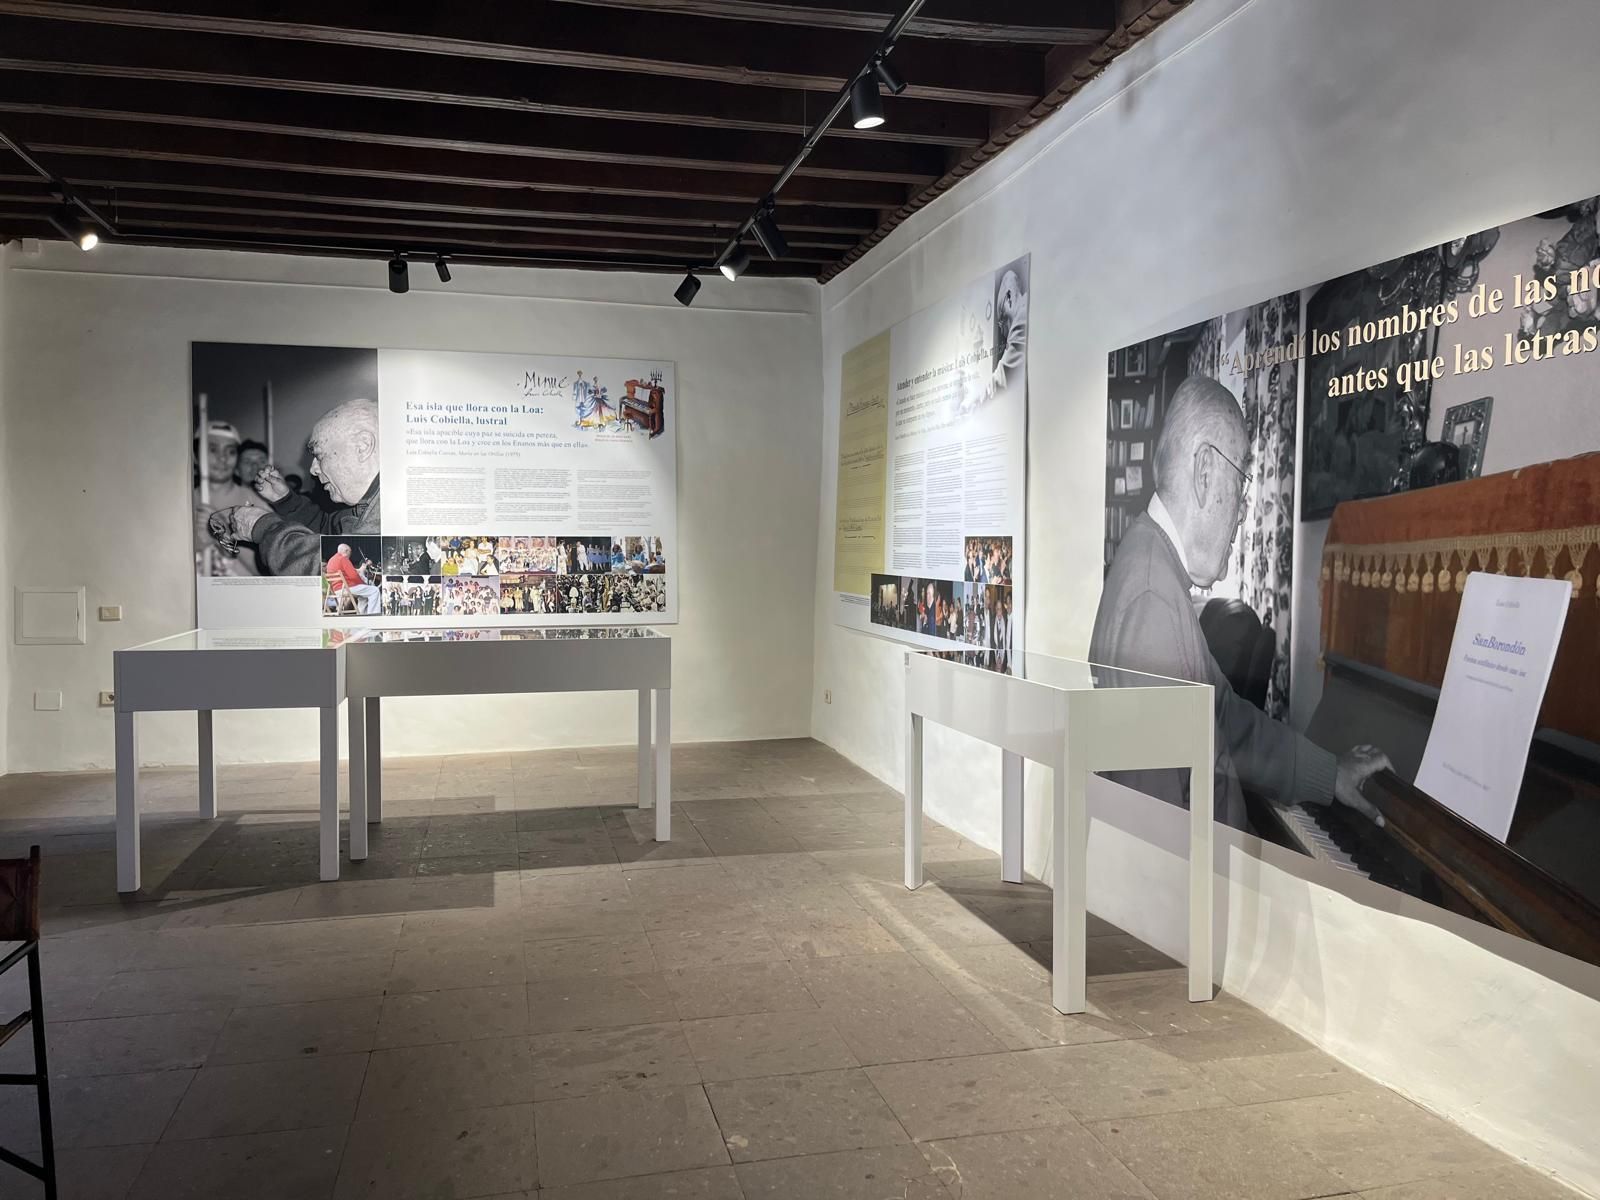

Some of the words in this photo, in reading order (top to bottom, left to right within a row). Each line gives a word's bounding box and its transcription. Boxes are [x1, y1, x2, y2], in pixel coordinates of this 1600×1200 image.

[1311, 328, 1341, 356] los
[1347, 299, 1459, 348] nombres
[1468, 283, 1504, 319] de
[1512, 273, 1557, 310] las
[1327, 365, 1388, 398] antes
[1395, 355, 1445, 393] que
[1453, 343, 1494, 375] las
[1503, 325, 1598, 366] letras
[406, 401, 424, 411] Esa
[426, 401, 443, 411] isla
[445, 404, 464, 414] que
[466, 402, 488, 412] llora
[490, 405, 508, 413] con
[510, 404, 519, 413] la
[522, 404, 545, 414] Loa:
[406, 414, 428, 423] Luis
[430, 414, 474, 425] Cobiella,
[476, 416, 507, 425] lustral
[423, 428, 435, 436] isla
[436, 429, 464, 438] apacible
[406, 438, 419, 446] que
[420, 437, 435, 445] llora
[457, 438, 470, 446] Loa
[501, 438, 512, 447] los
[512, 439, 536, 447] Enanos
[537, 440, 550, 448] más
[551, 441, 563, 449] que
